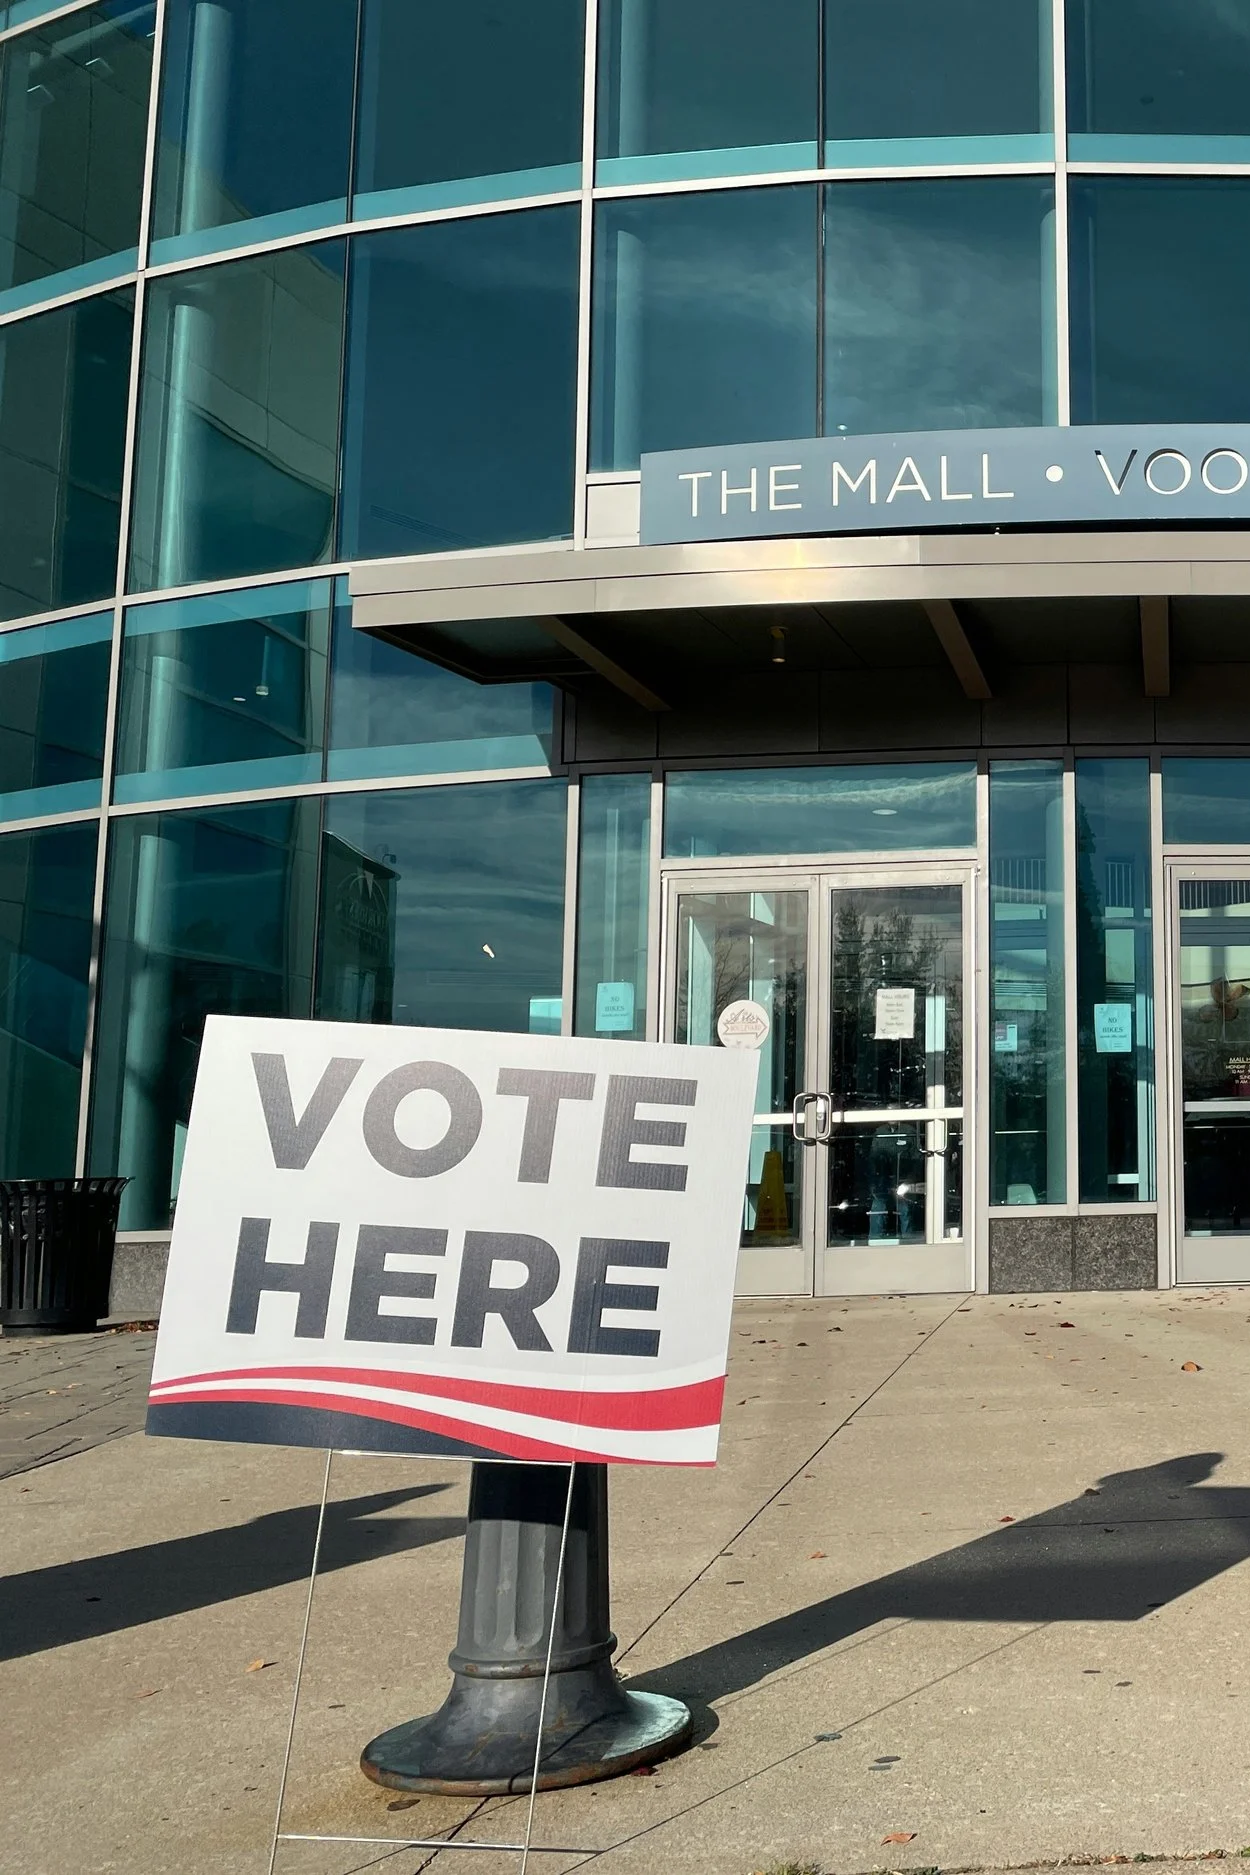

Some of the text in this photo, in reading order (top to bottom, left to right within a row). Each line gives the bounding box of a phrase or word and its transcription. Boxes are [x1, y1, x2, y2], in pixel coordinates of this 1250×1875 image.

[678, 464, 803, 518] THE
[832, 452, 1015, 507] MALL
[250, 1052, 698, 1192] VOTE
[225, 1217, 671, 1357] HERE
